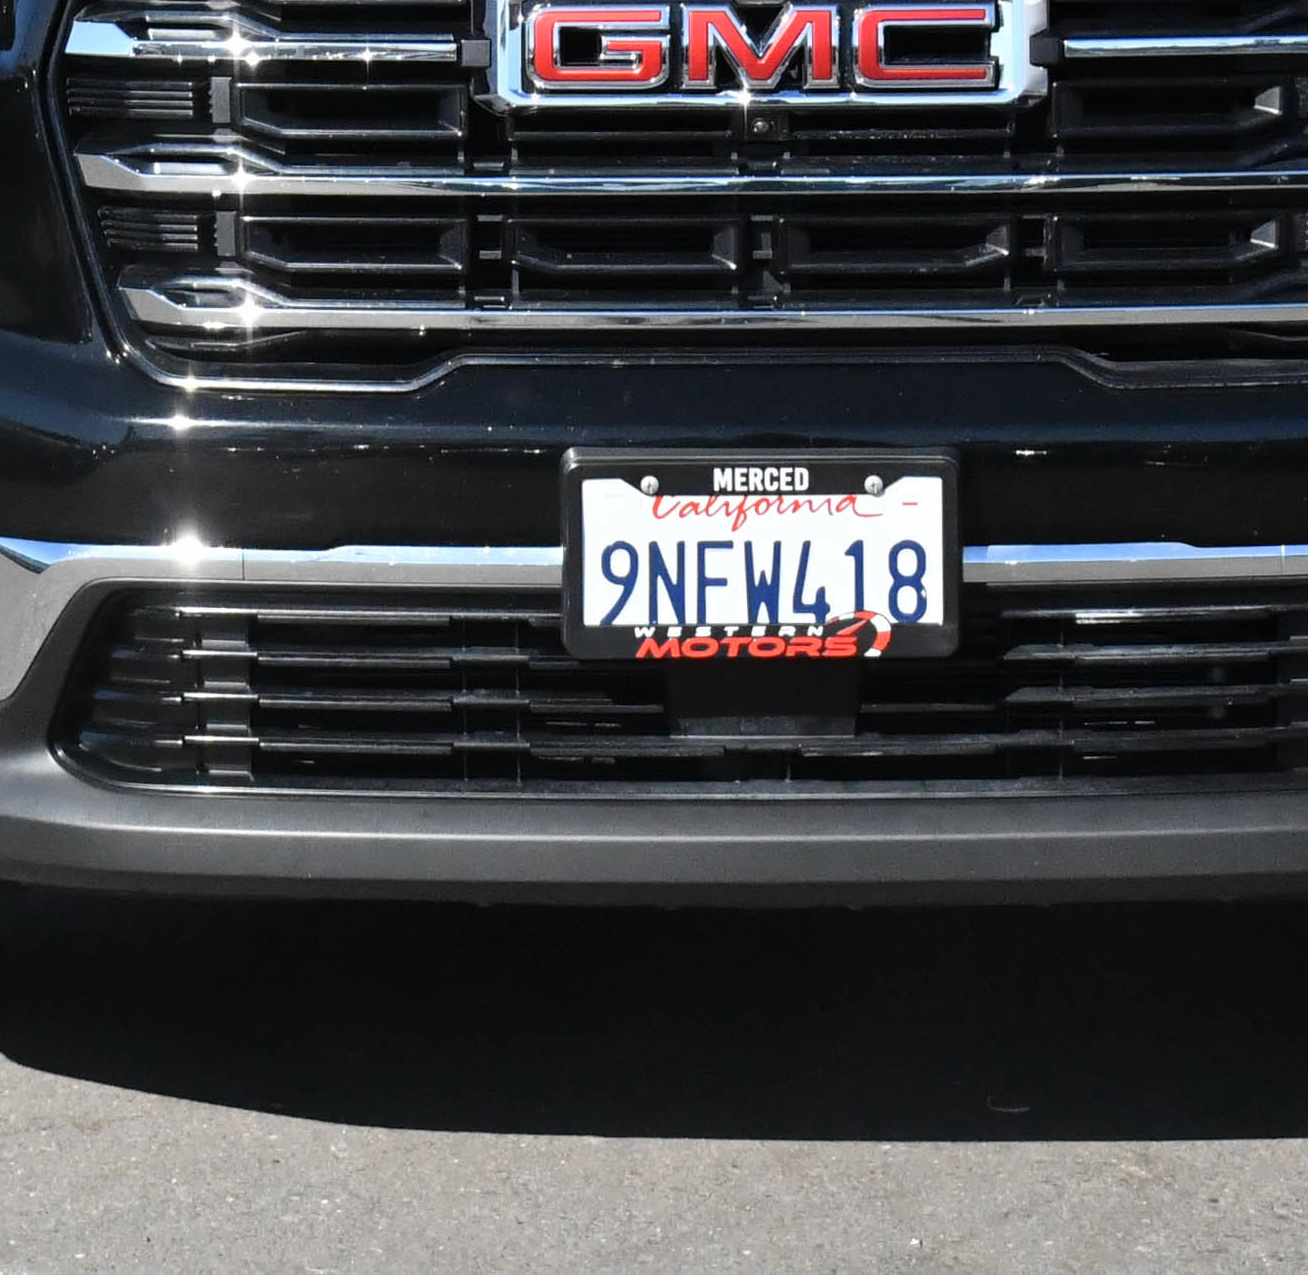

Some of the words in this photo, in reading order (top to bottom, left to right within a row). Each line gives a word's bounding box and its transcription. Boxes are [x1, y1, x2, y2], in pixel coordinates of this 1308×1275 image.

[527, 5, 995, 90] GMC
[713, 467, 810, 493] MERCED
[652, 494, 883, 533] California
[600, 539, 928, 625] 9NFW418
[633, 626, 824, 638] WESTERN
[635, 635, 859, 660] MOTORS
